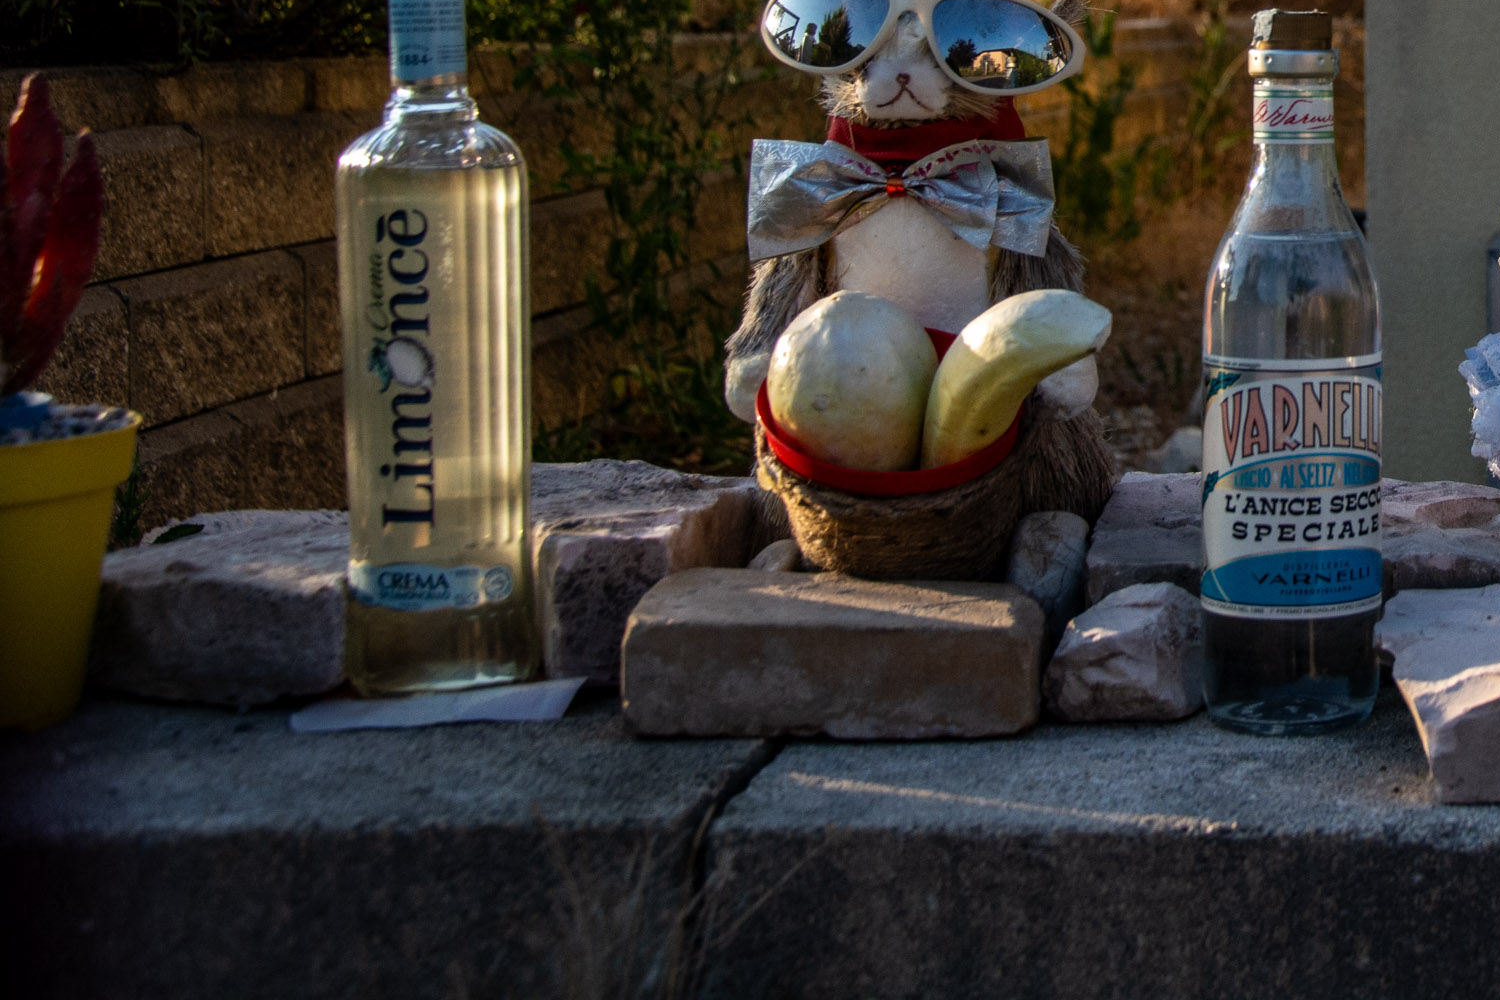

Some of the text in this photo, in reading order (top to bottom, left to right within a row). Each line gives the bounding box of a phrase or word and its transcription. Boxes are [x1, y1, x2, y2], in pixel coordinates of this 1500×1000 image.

[1279, 464, 1297, 489] AL
[1298, 462, 1336, 488] SELTZ
[1225, 493, 1322, 516] L'ANICE
[1232, 514, 1379, 542] SPECIALE
[378, 571, 450, 590] CREMA
[1252, 566, 1370, 585] VARNELLI
